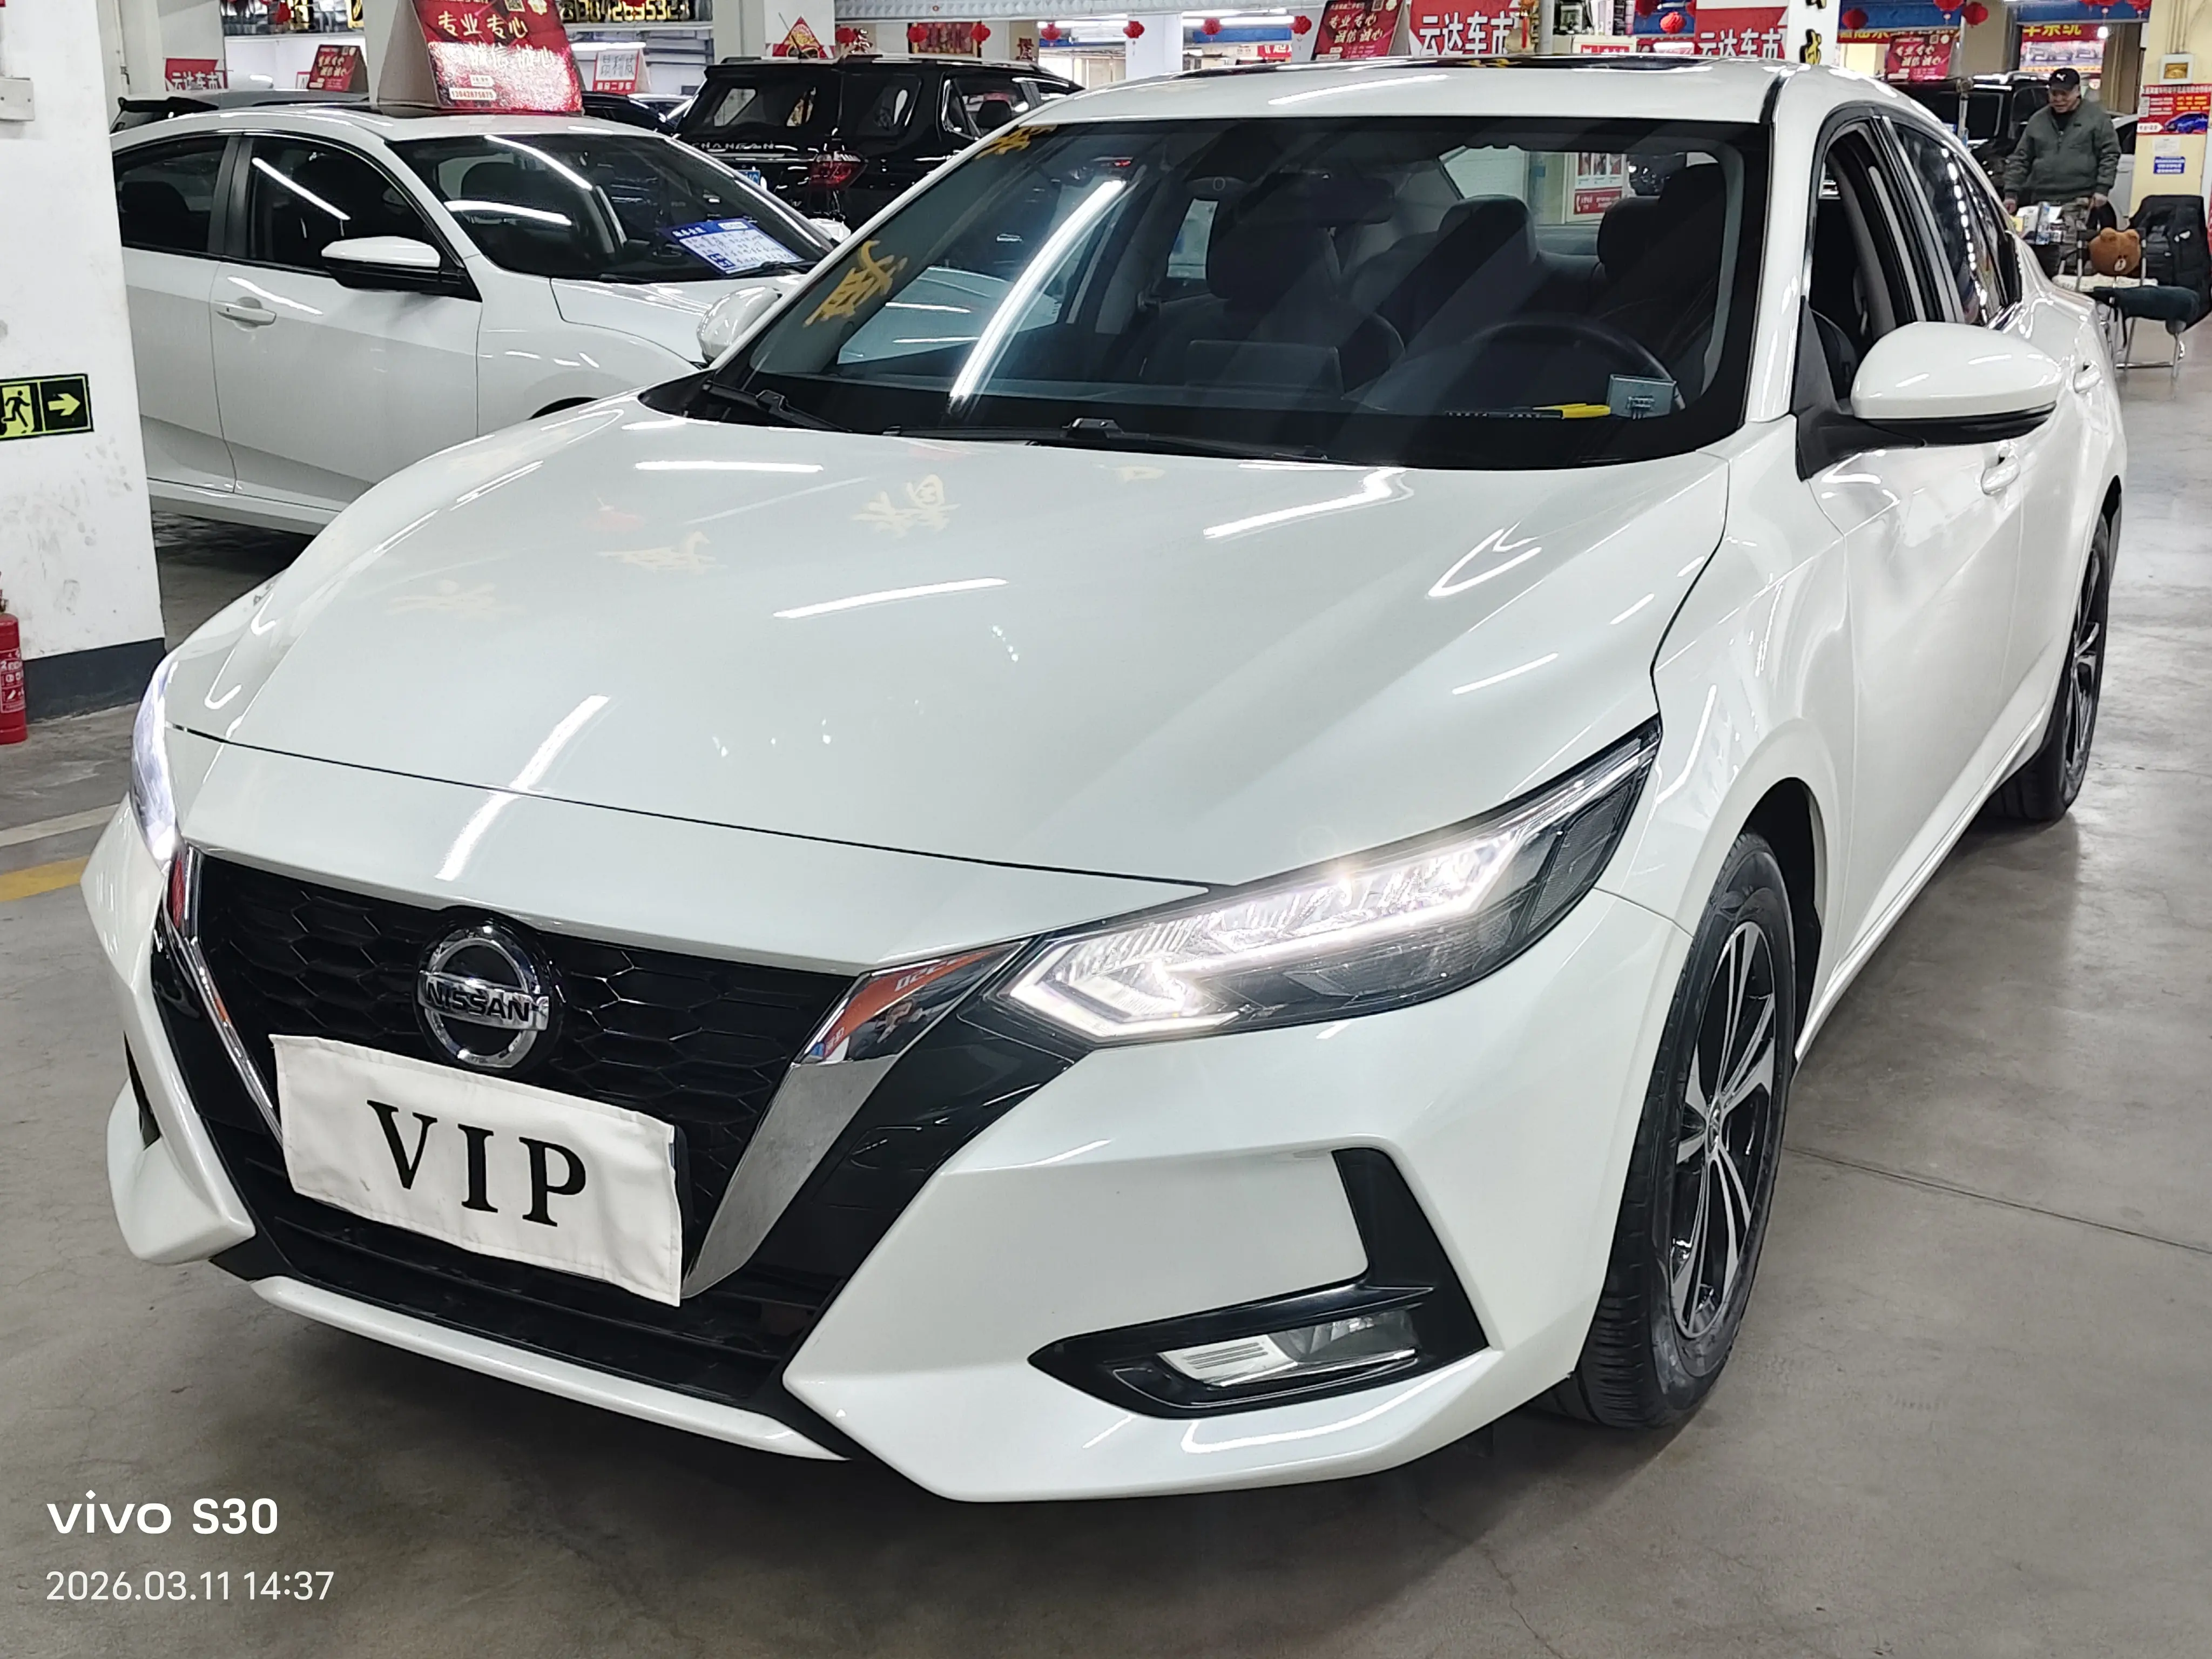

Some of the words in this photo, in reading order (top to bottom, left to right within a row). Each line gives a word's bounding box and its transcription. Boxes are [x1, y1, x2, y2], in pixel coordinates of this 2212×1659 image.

[439, 11, 482, 36] 专业
[487, 14, 528, 38] 专心
[1420, 11, 1513, 54] 云达车市
[1698, 28, 1782, 58] 云达车市
[426, 980, 530, 1022] NISSAN
[366, 1100, 586, 1227] VIP
